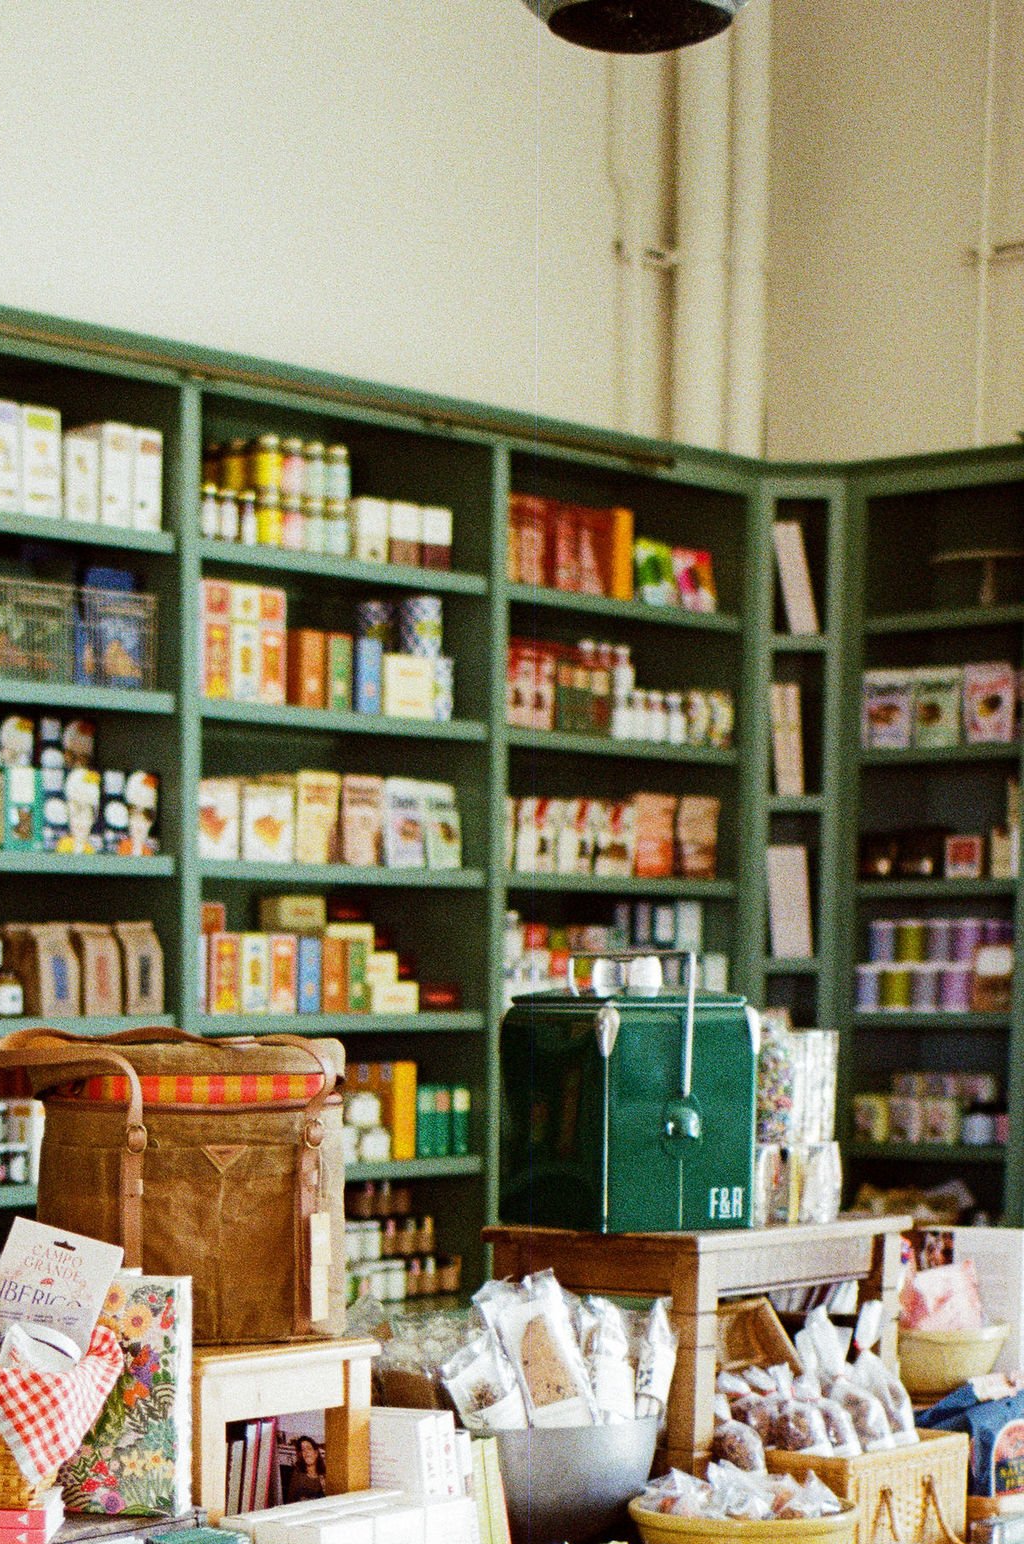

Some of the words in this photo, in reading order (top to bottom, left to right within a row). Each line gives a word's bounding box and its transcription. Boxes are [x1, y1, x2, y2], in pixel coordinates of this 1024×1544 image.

[709, 1187, 743, 1219] F&R
[24, 1256, 81, 1283] GRANDE
[32, 1244, 84, 1268] CAMPO
